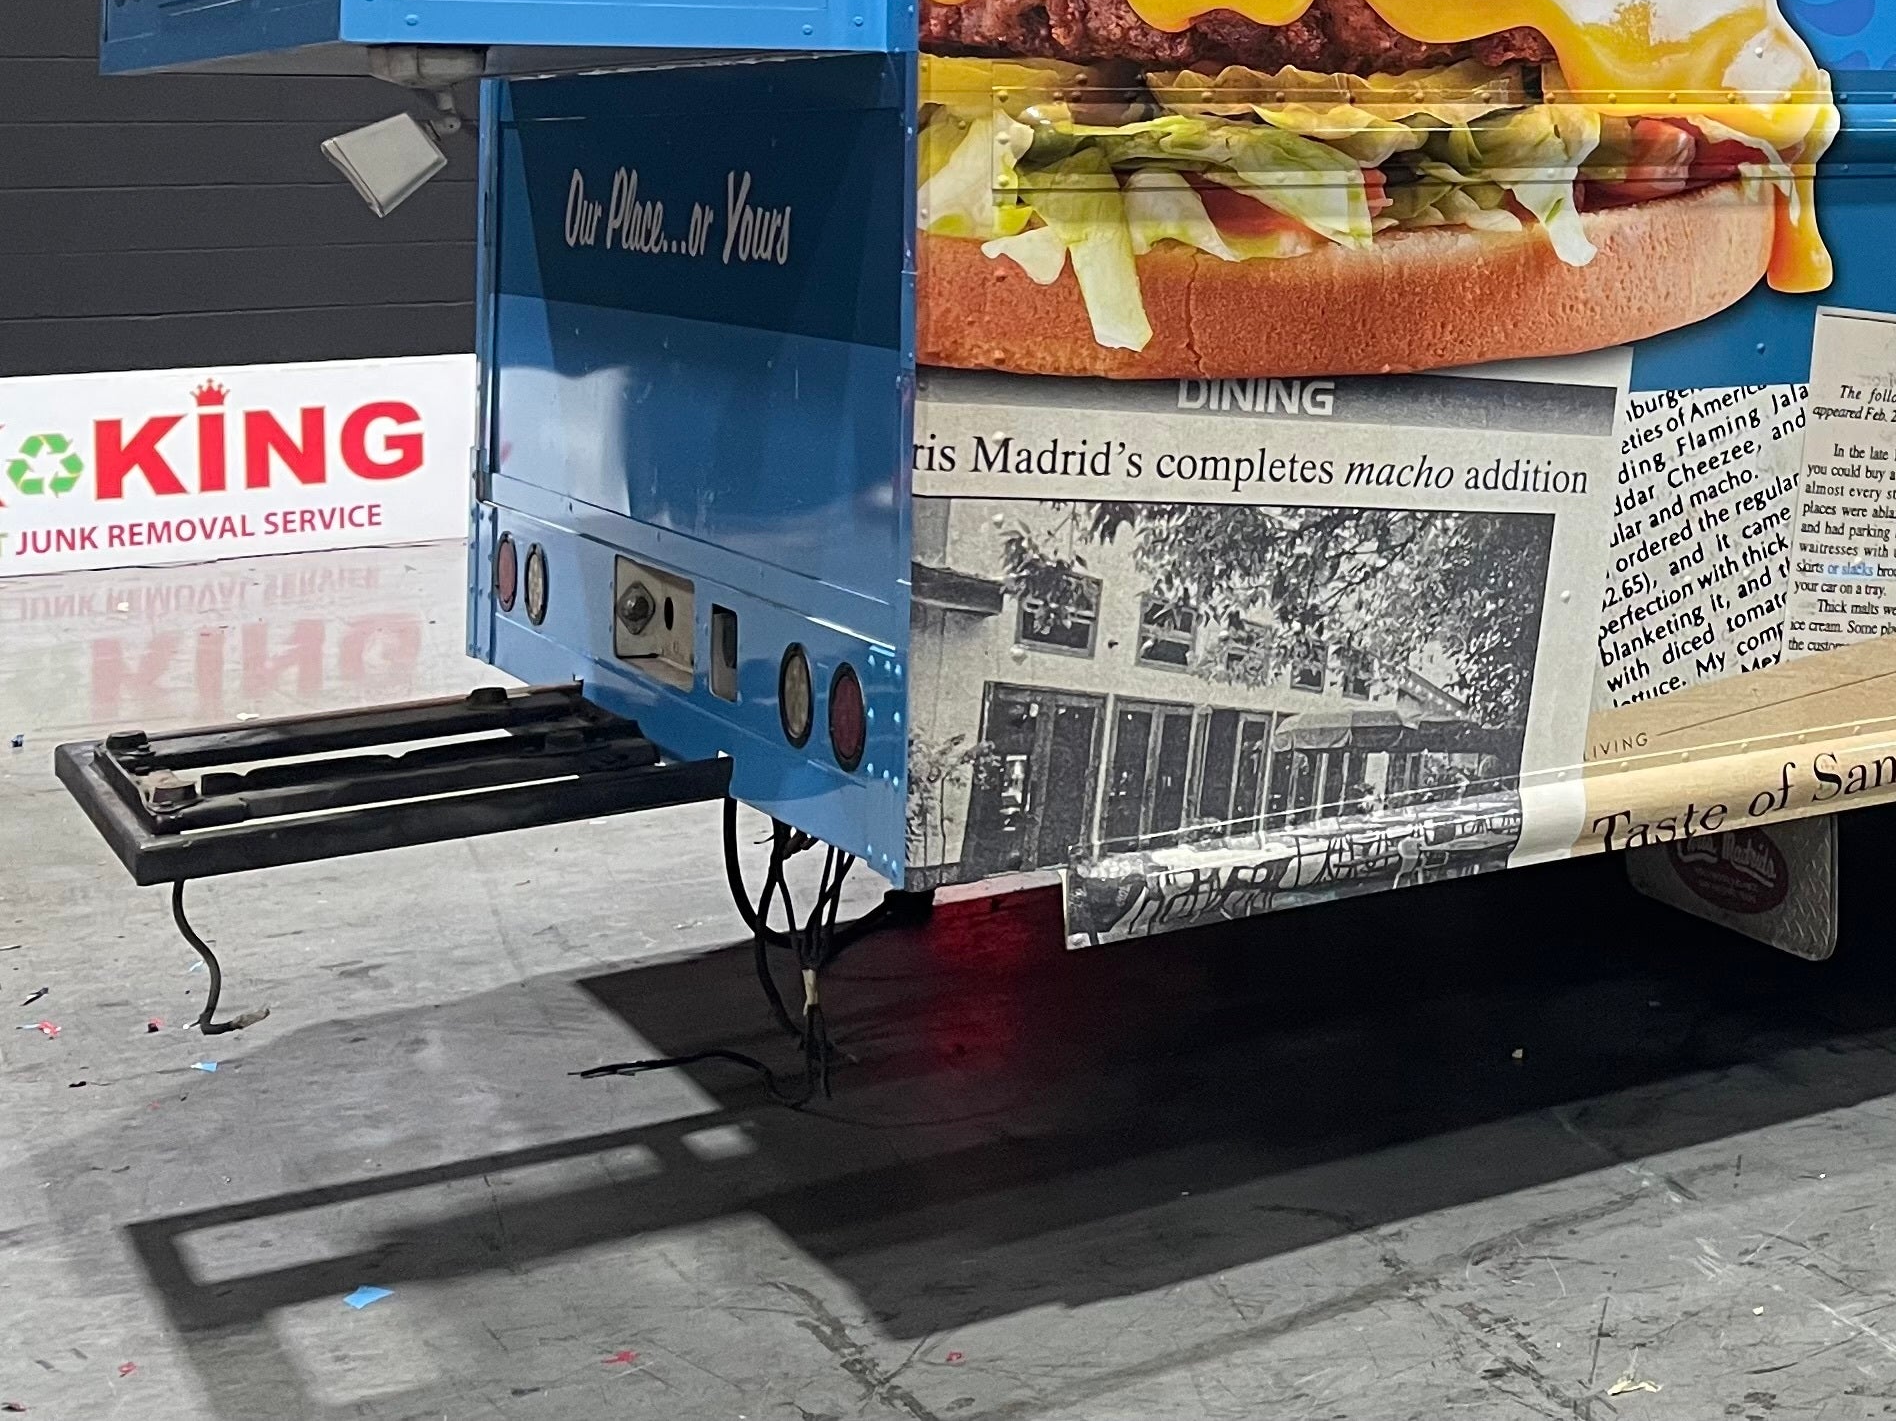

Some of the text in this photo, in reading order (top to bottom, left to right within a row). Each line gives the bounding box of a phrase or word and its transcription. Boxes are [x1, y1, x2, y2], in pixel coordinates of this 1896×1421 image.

[565, 168, 602, 247] Our
[722, 170, 791, 265] Yours
[1176, 378, 1335, 417] DINING
[1840, 385, 1861, 400] The
[1667, 407, 1685, 432] of
[1813, 405, 1863, 420] appeared
[1865, 408, 1888, 421] Feb.
[94, 393, 425, 500] KING
[1618, 452, 1666, 485] ding
[1677, 408, 1761, 457] Flaming
[1668, 407, 1806, 489] Cheezee, and
[1834, 444, 1844, 457] In
[1849, 445, 1865, 459] the
[1870, 446, 1888, 460] late
[969, 435, 1143, 480] Madrid's
[1155, 445, 1335, 490] completes
[1345, 454, 1454, 490] macho
[1464, 463, 1589, 496] addition
[1807, 464, 1827, 477] you
[1831, 464, 1861, 477] could
[1865, 466, 1885, 483] buy
[1890, 471, 1895, 480] a
[1650, 494, 1683, 529] and
[1690, 468, 1759, 508] macho.
[1805, 481, 1844, 497] almost
[1849, 488, 1881, 502] every
[1802, 500, 1836, 516] places
[1842, 506, 1868, 517] were
[16, 504, 382, 555] JUNK REMOVAL SERVICE
[1616, 472, 1799, 573] ordered the regular
[1801, 521, 1820, 533] and
[1825, 521, 1845, 535] had
[1848, 524, 1890, 542] parking
[1669, 542, 1704, 576] and
[1717, 534, 1731, 552] it
[1742, 506, 1792, 539] came
[1799, 540, 1858, 556] waitresses
[1864, 544, 1888, 558] with
[1697, 560, 1737, 590] with
[1742, 538, 1789, 569] thick
[1796, 558, 1825, 573] skirts
[1828, 564, 1839, 574] or
[1842, 562, 1873, 576] slacks
[1793, 580, 1887, 599] your car on a tray.
[1601, 605, 1705, 667] blanketing
[1710, 594, 1730, 612] it,
[1737, 565, 1772, 599] and
[1818, 599, 1847, 613] Thick
[1850, 602, 1879, 615] malts
[1847, 621, 1878, 635] Some
[1788, 637, 1804, 650] the
[1607, 658, 1649, 692] with
[1662, 622, 1714, 664] diced
[1696, 652, 1725, 677] My
[1592, 803, 1728, 853] Taste
[1747, 762, 1796, 818] of
